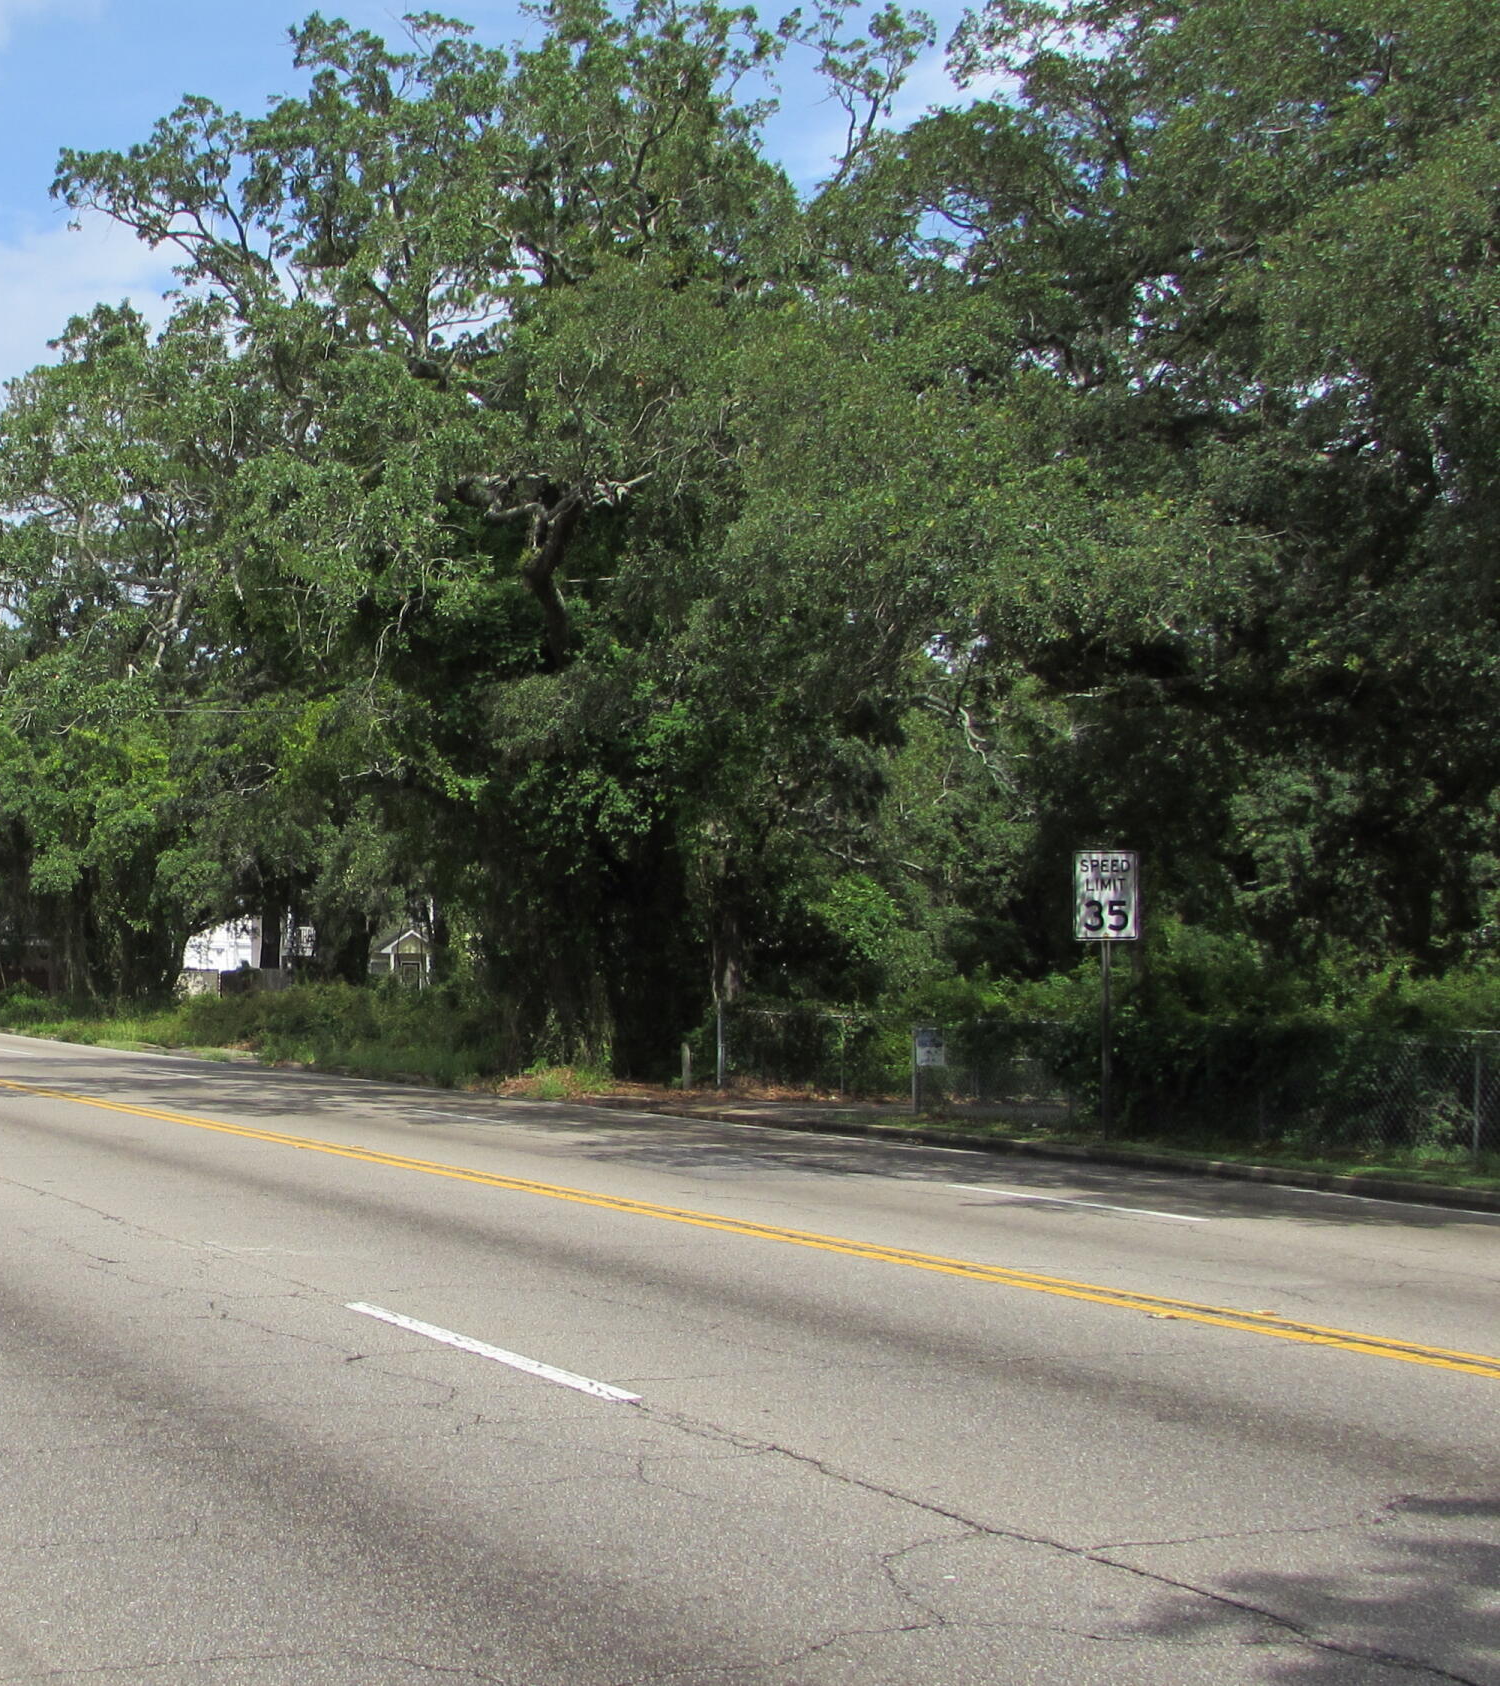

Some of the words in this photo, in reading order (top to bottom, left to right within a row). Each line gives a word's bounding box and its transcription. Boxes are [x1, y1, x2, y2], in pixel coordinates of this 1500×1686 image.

[1080, 859, 1130, 873] SPEED
[1086, 878, 1125, 892] LIMIT
[1084, 900, 1128, 931] 35
